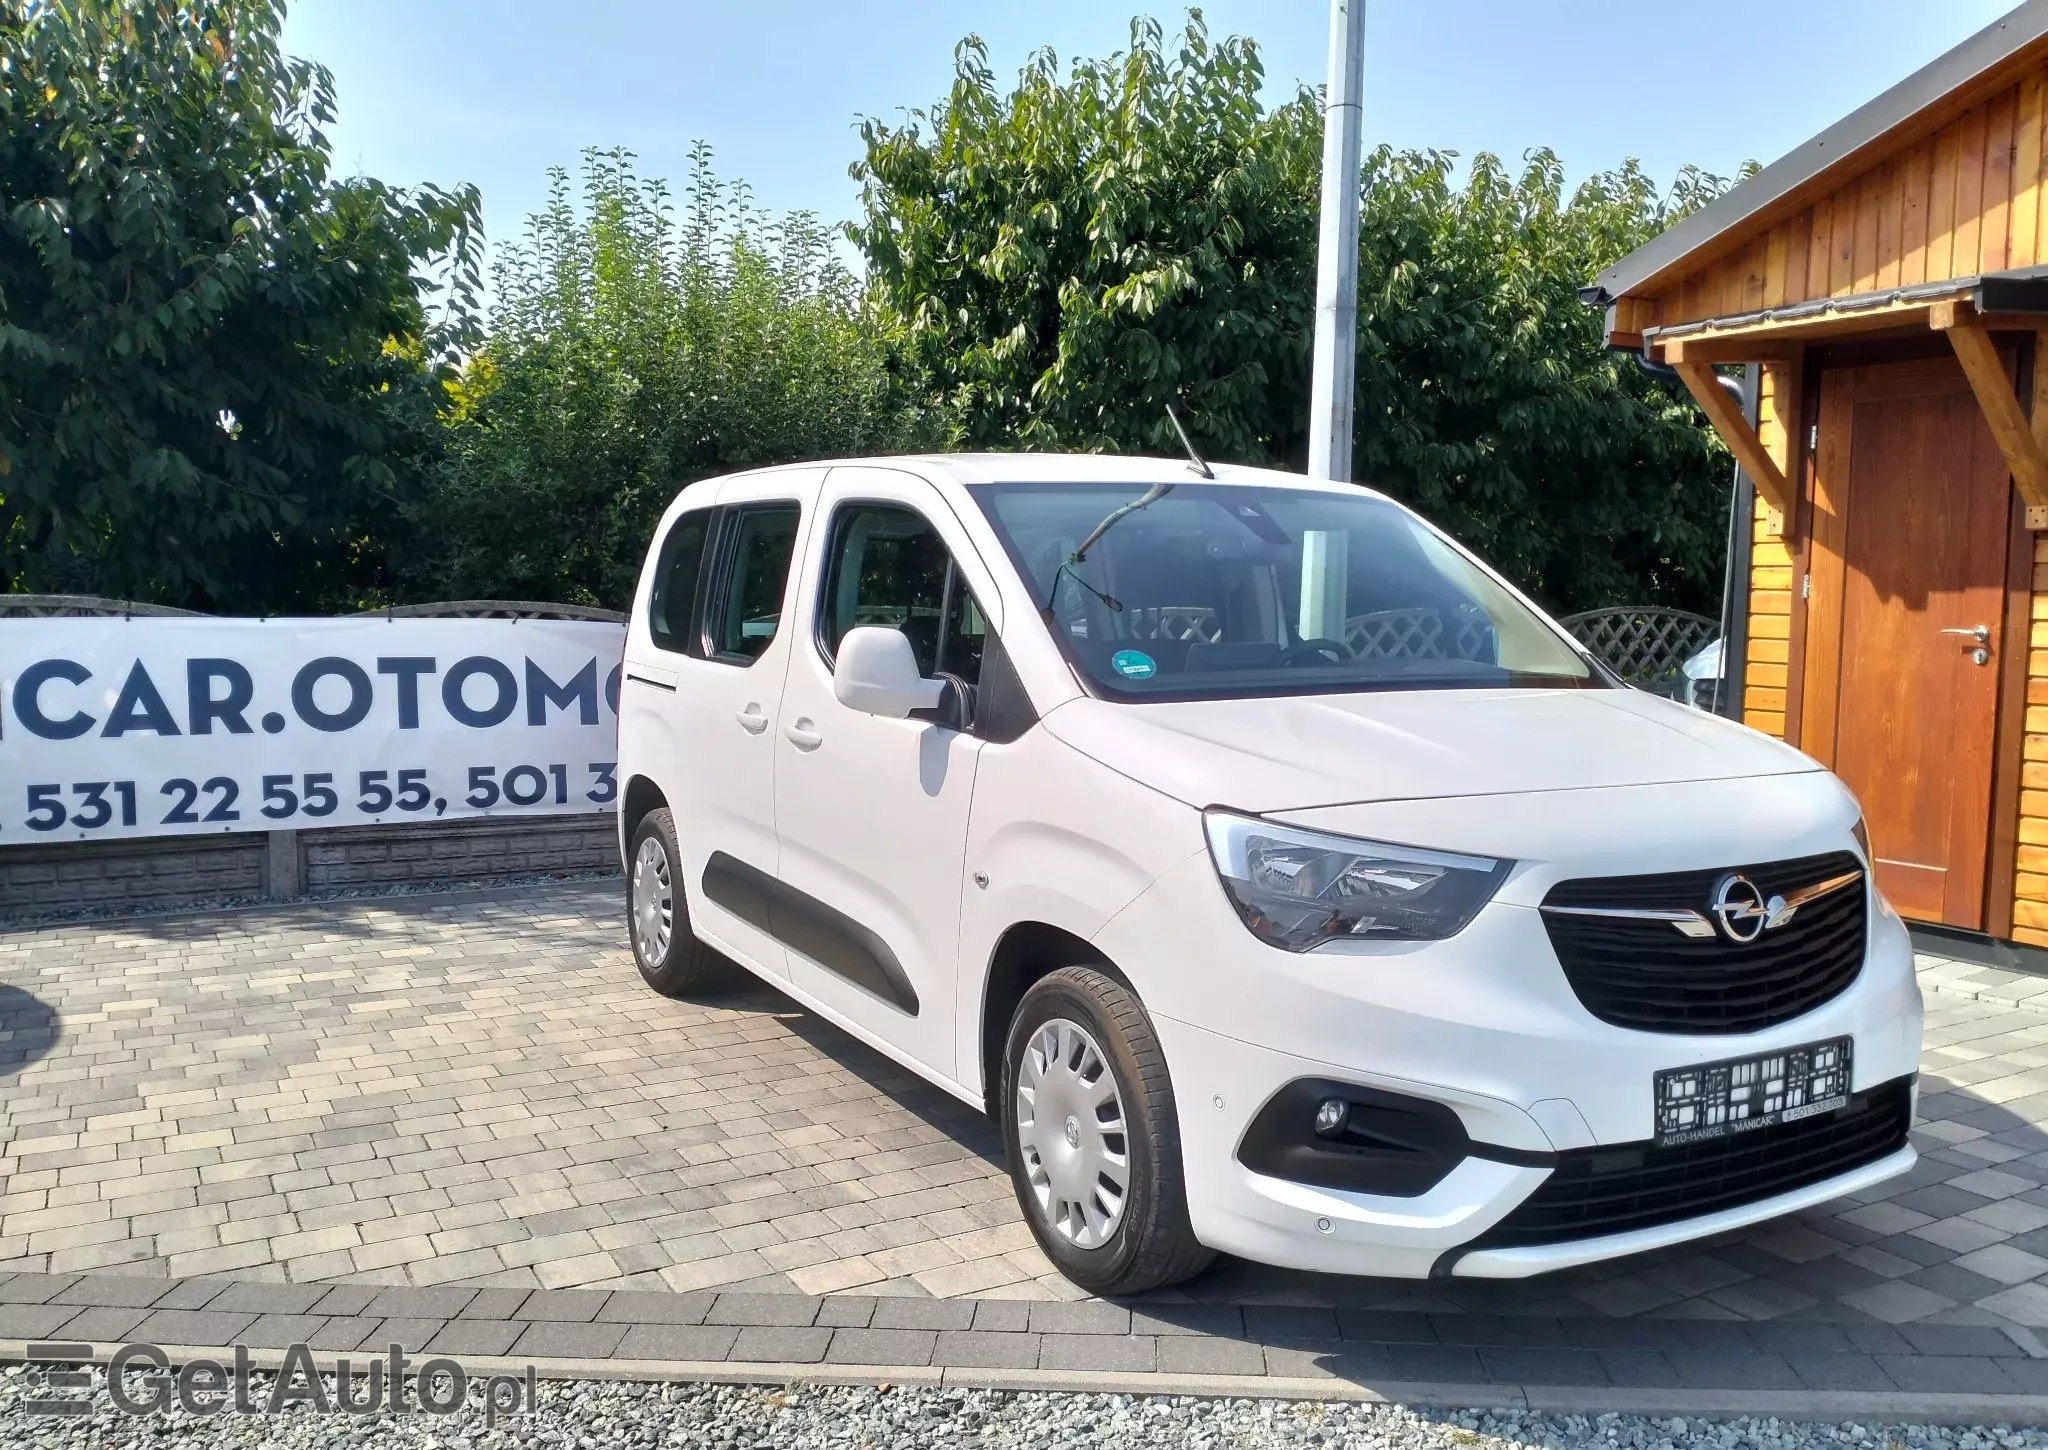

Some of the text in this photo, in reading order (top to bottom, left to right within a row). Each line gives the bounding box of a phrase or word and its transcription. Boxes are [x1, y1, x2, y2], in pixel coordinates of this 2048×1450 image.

[0, 655, 621, 740] CAR.OTOM
[24, 781, 137, 831] 531
[160, 776, 241, 825] 22
[260, 772, 339, 819] 55
[357, 768, 447, 817] 55,
[465, 764, 568, 808] 501
[1662, 1126, 1726, 1147] AUTO-HANDEL
